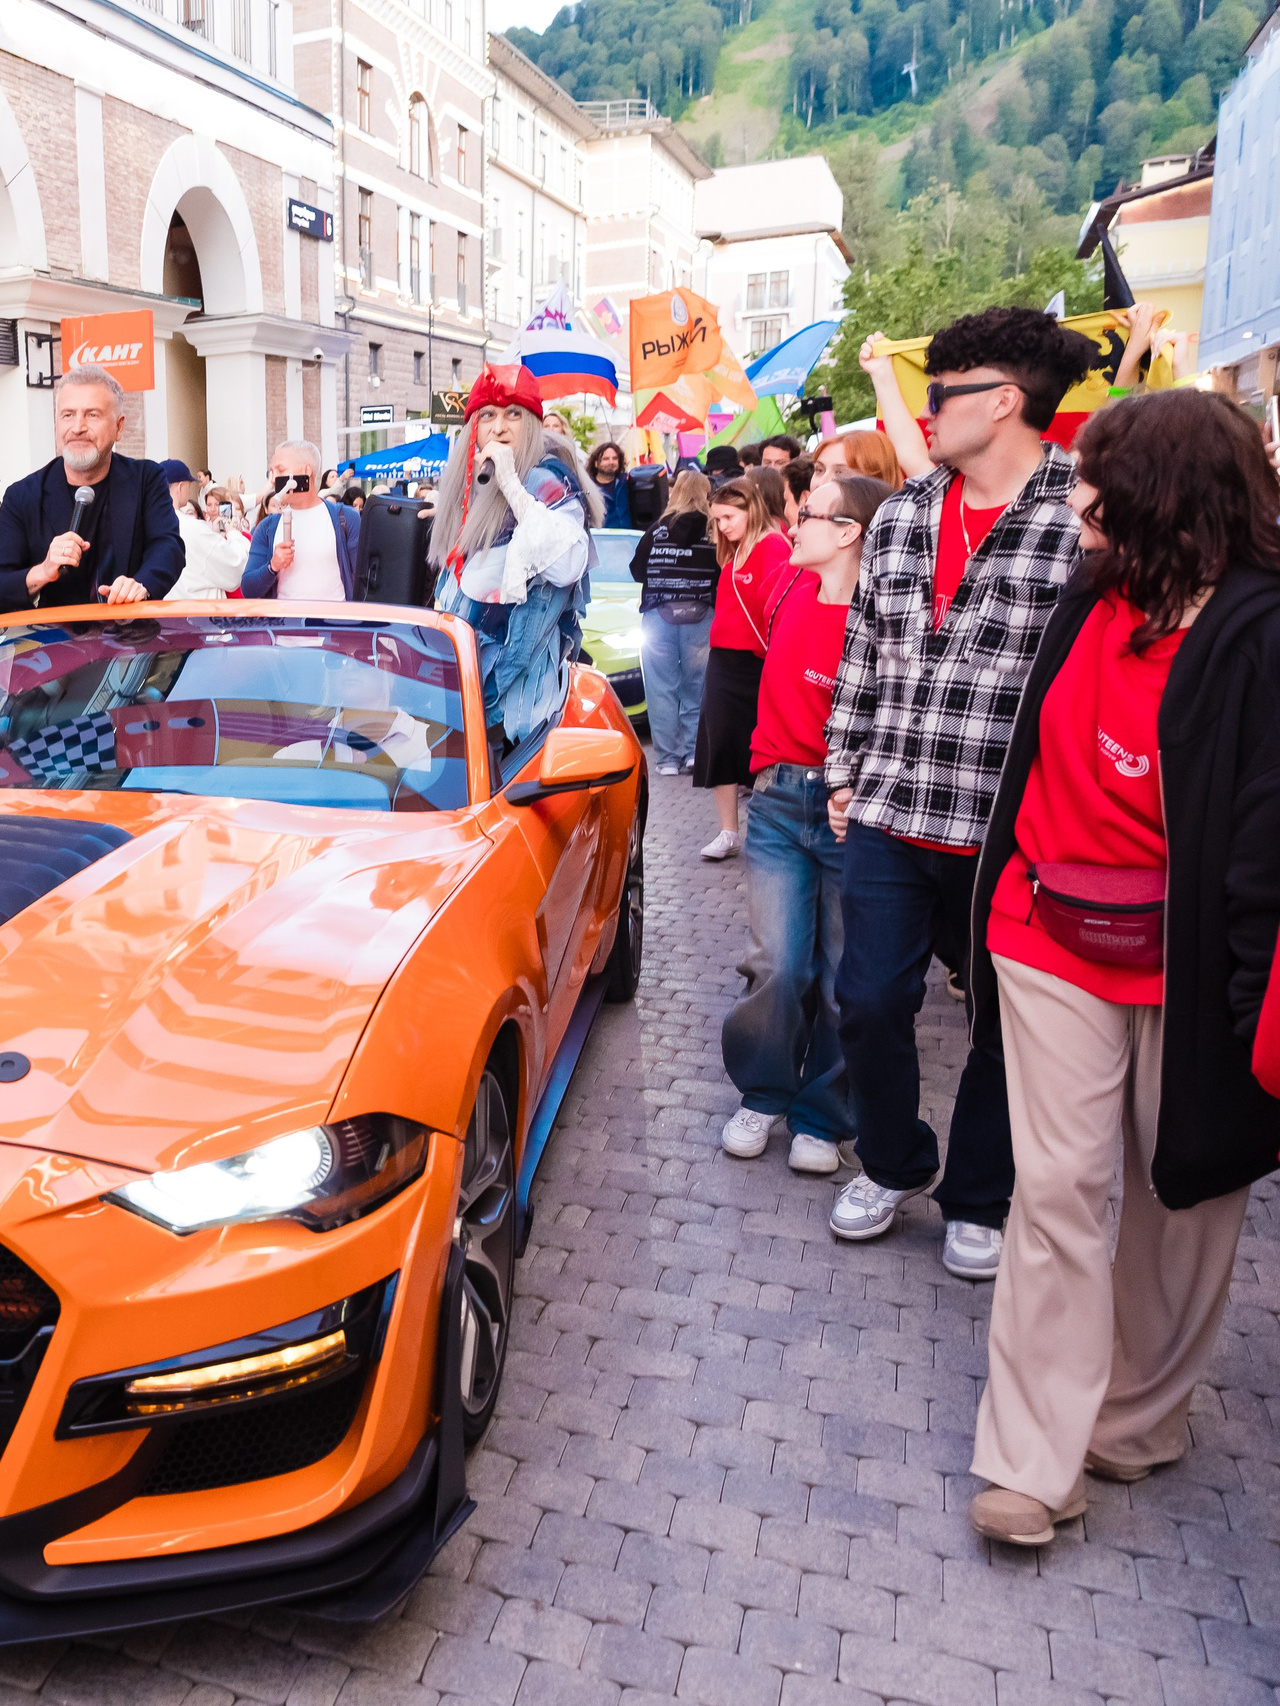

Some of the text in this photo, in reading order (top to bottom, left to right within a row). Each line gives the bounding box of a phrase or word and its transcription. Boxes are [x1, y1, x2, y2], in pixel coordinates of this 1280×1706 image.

[81, 343, 143, 363] КАНТ
[804, 668, 837, 686] AGUTEEN
[1098, 727, 1134, 763] UTEENS
